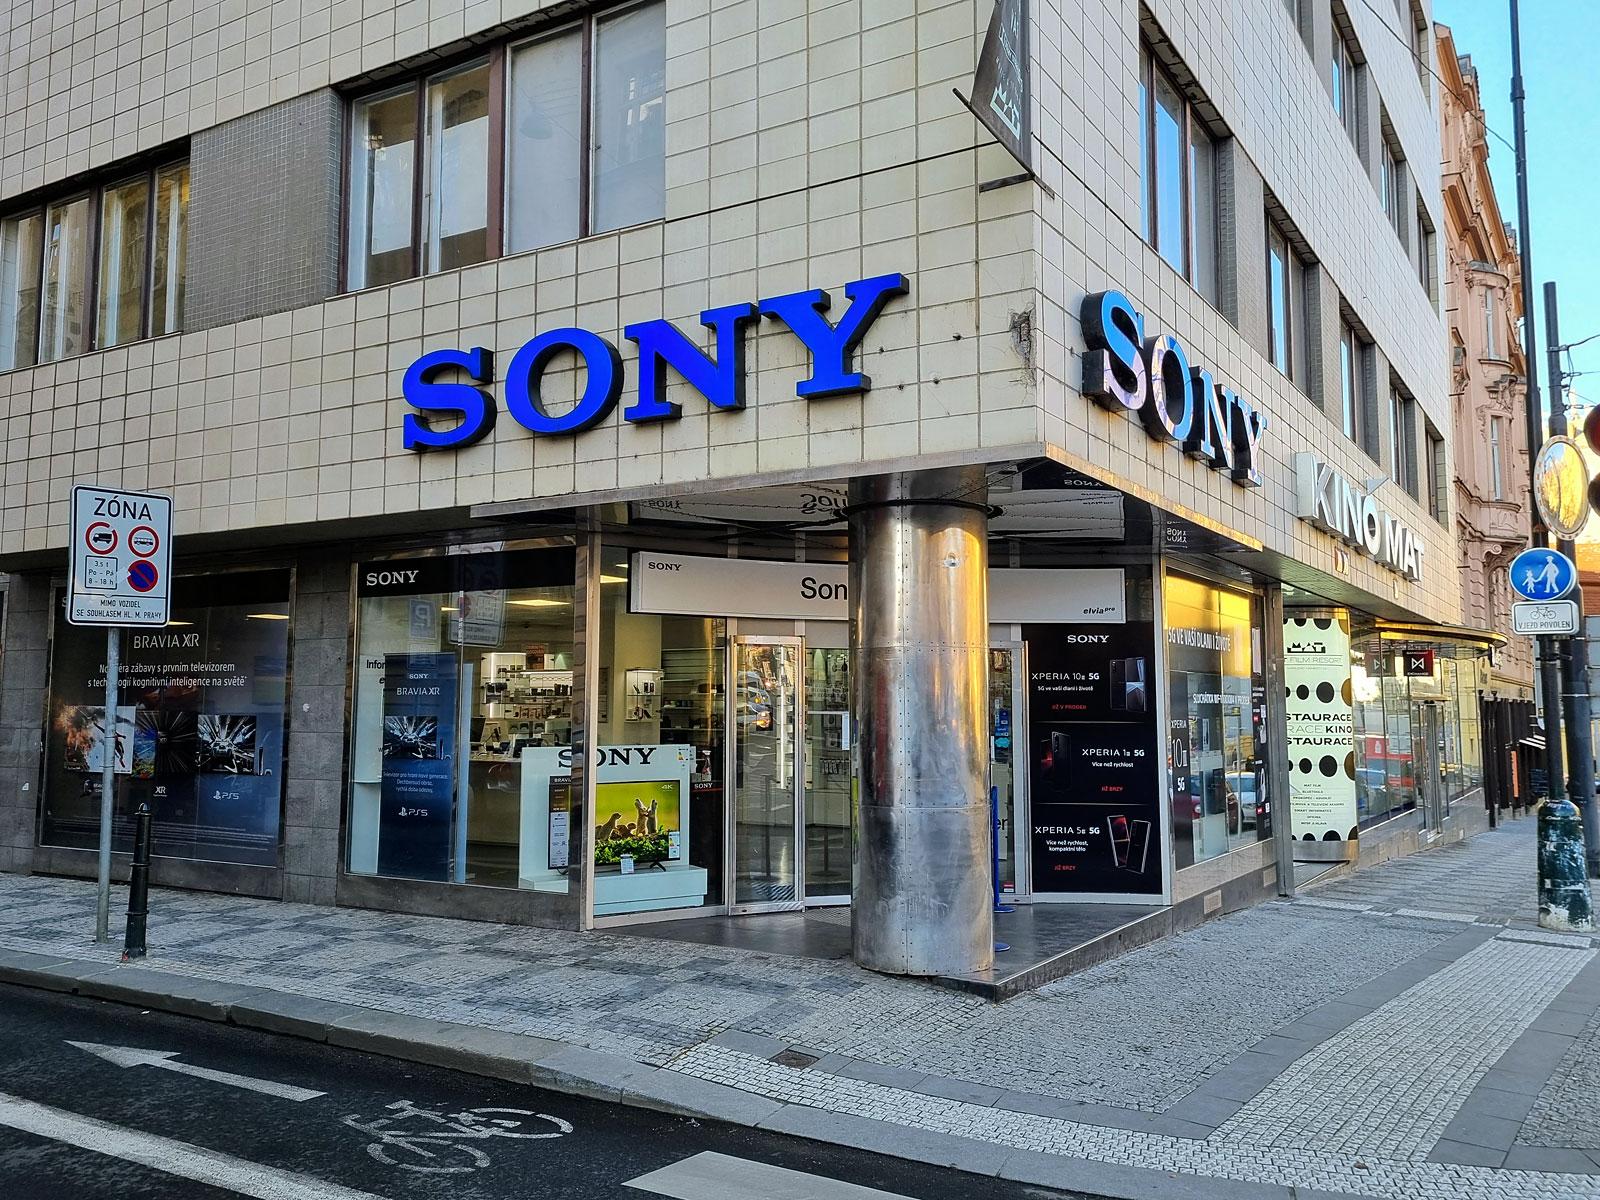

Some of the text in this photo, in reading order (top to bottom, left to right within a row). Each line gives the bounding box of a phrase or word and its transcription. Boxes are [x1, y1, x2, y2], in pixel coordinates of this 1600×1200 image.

[401, 272, 910, 451] SONY
[1079, 290, 1267, 487] SONY
[93, 496, 153, 521] ZÓNA
[1297, 452, 1424, 582] KINO MAT
[648, 561, 682, 571] SONY
[366, 570, 419, 586] SONY
[100, 599, 141, 608] MIMO VOZIDEL
[76, 609, 84, 617] SE
[86, 610, 122, 618] SOUHLASEM
[144, 612, 162, 620] PRAHY
[1518, 620, 1571, 630] VJEZD POVOLEN
[134, 634, 200, 649] BRAVIA XR
[1067, 635, 1110, 643] SONY
[1168, 627, 1176, 643] 5G
[1176, 628, 1184, 644] VE
[1184, 628, 1196, 646] VAŠÍ
[1197, 632, 1212, 649] DLANI
[118, 663, 130, 673] éra
[131, 662, 156, 674] zábavy
[162, 662, 189, 674] prvním
[190, 662, 235, 672] televizorem
[93, 676, 132, 688] techogií
[133, 676, 168, 688] kognitivní
[169, 676, 210, 688] inteligence
[212, 678, 222, 686] na
[397, 688, 428, 696] BRAVIA
[1171, 720, 1187, 729] XPERIA
[1326, 726, 1353, 734] KINO
[1082, 749, 1120, 757] XPERIA
[1178, 777, 1185, 792] 5G
[222, 792, 240, 800] PS5
[409, 809, 428, 817] PS5
[1089, 827, 1100, 835] 5G
